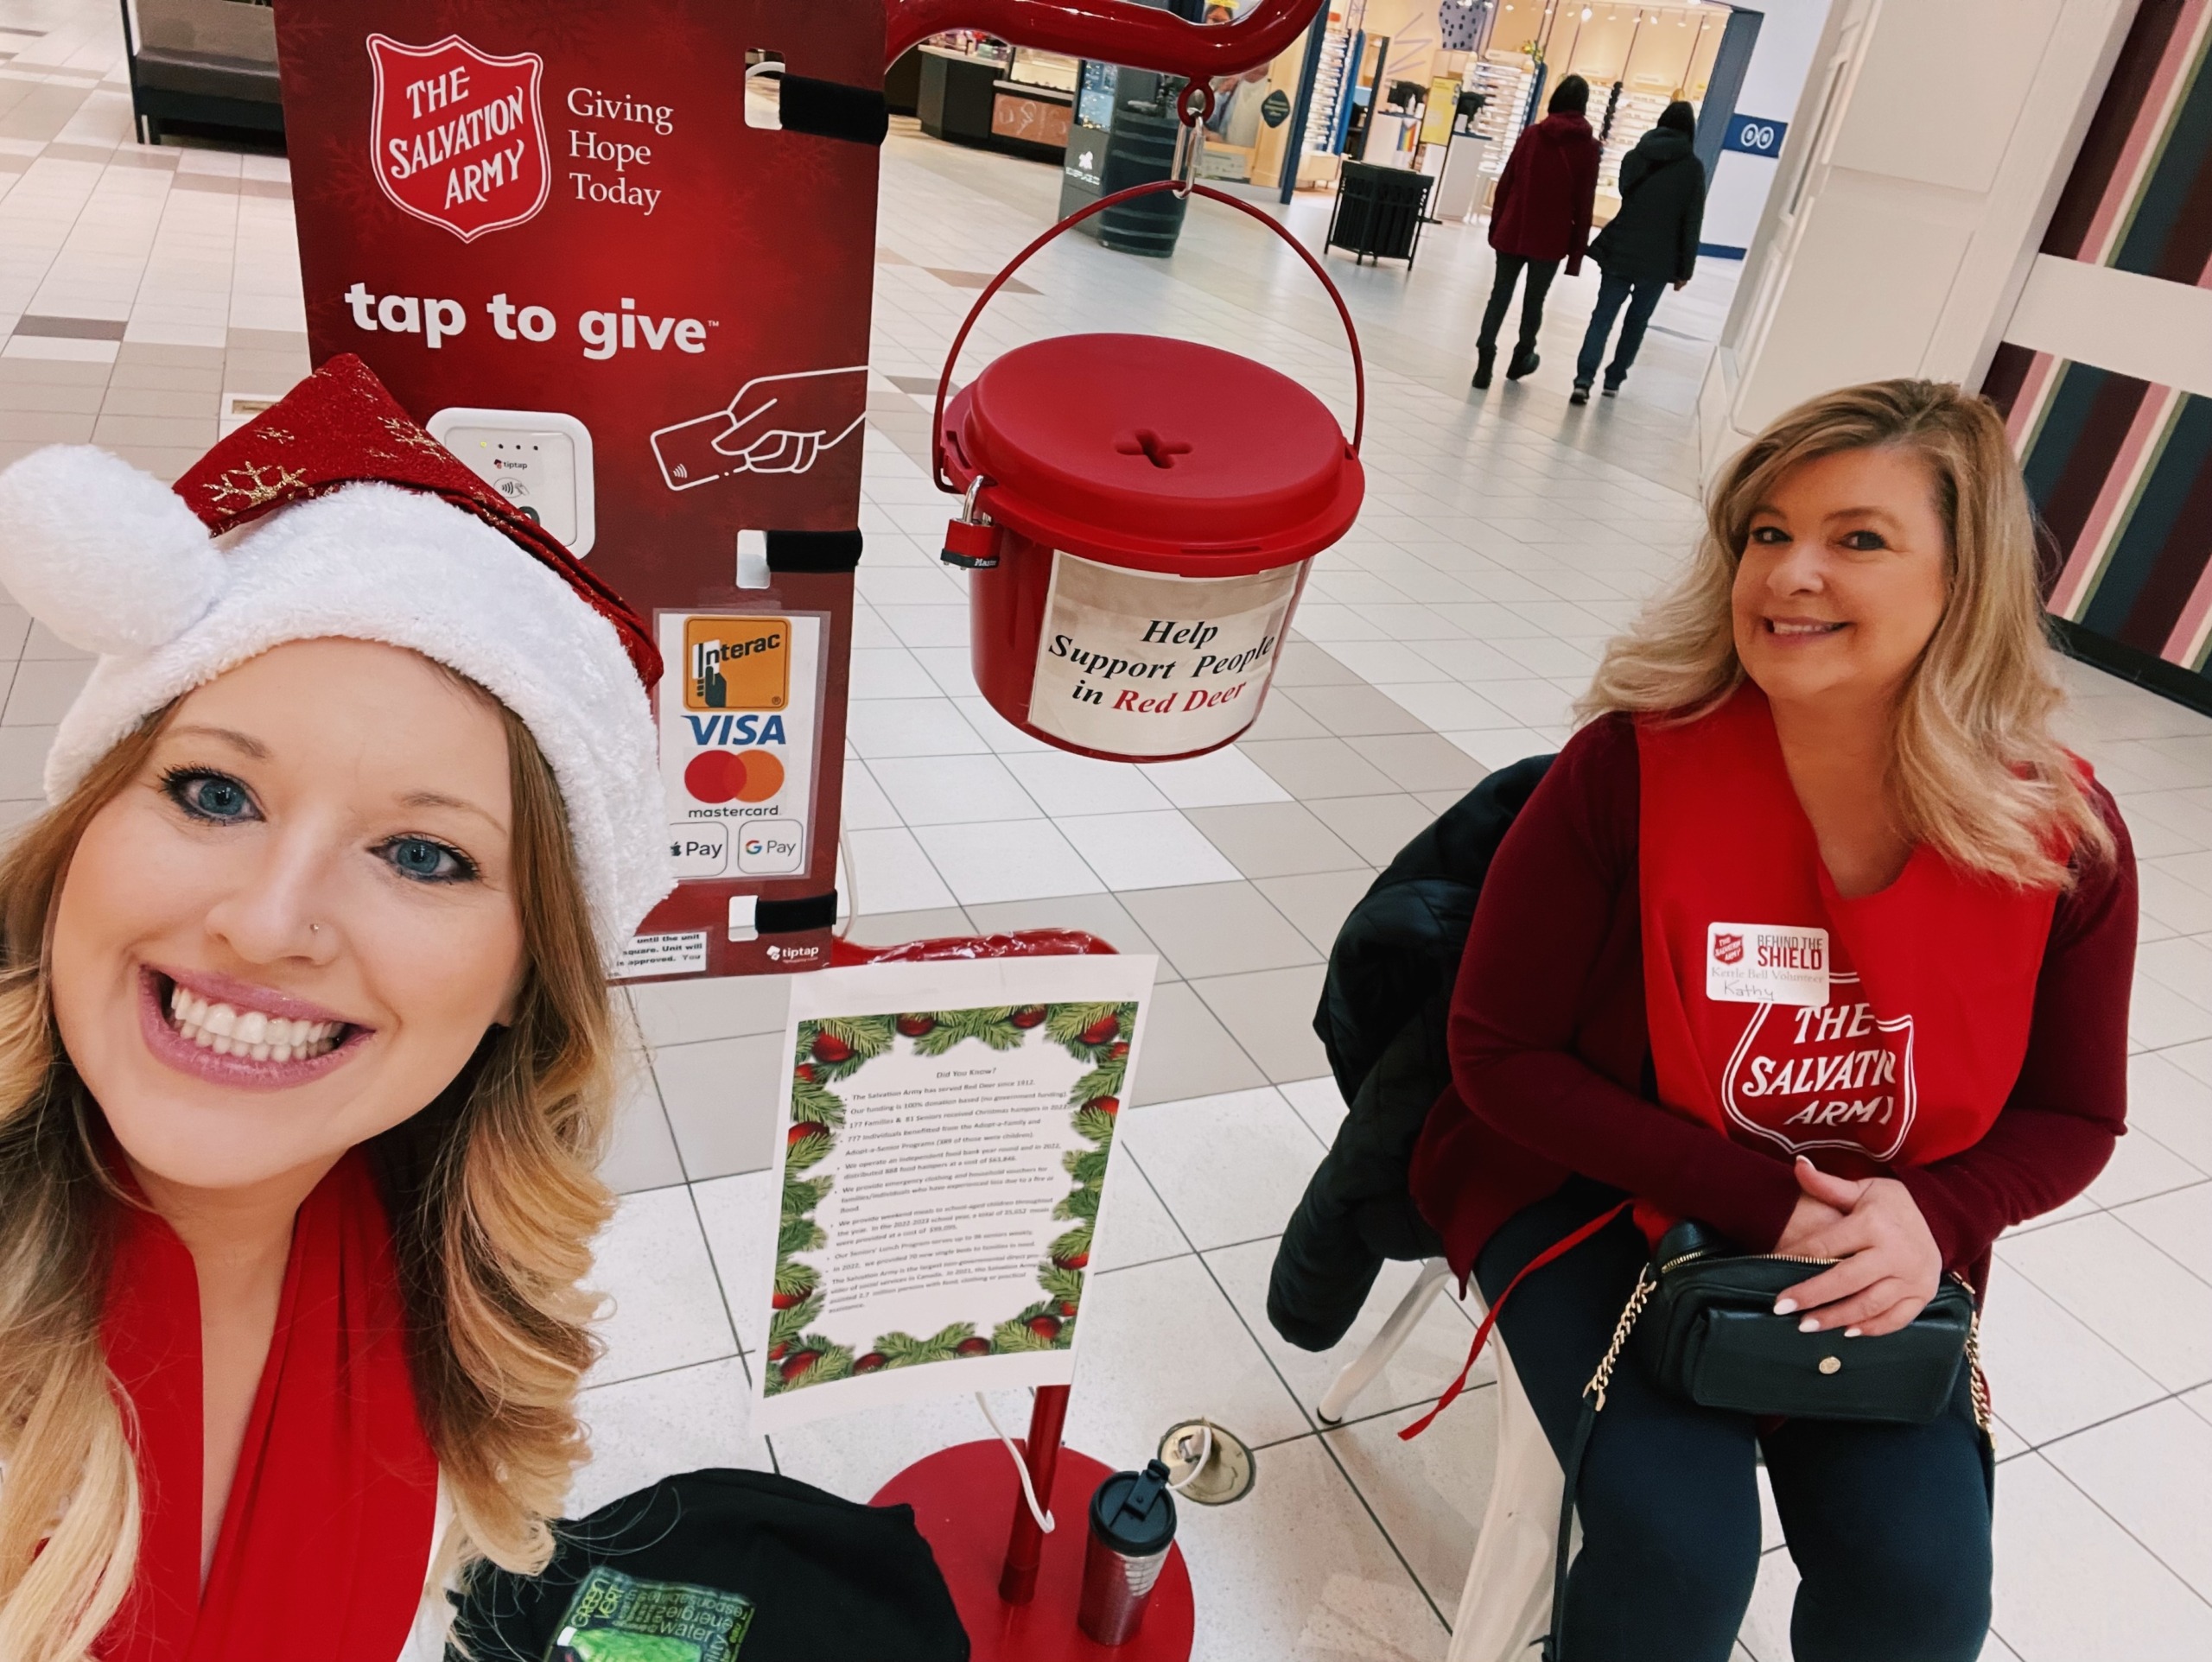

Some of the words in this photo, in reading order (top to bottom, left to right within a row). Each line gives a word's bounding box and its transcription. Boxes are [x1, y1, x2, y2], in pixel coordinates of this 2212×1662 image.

[406, 66, 470, 119] THE
[567, 87, 674, 135] Giving
[389, 86, 523, 179] SALVATION
[569, 130, 652, 172] Hope
[444, 139, 524, 210] ARMY
[570, 173, 662, 215] Today
[345, 282, 466, 348] tap
[486, 293, 556, 341] to
[504, 461, 528, 470] tiptap
[1140, 619, 1219, 650] Help
[698, 633, 781, 678] Interac
[1048, 633, 1177, 680] Support
[1191, 635, 1275, 679] People
[1071, 679, 1104, 706] in
[1111, 689, 1178, 714] Red
[1182, 681, 1247, 714] Deer
[680, 714, 786, 745] VISA
[688, 805, 779, 818] mastercard
[685, 842, 723, 859] Pay
[746, 840, 763, 854] G
[766, 840, 797, 857] Pay
[783, 947, 819, 960] tiptap
[1758, 935, 1798, 949] BEHIND
[1802, 937, 1823, 949] THE
[627, 956, 677, 966] approved.
[1758, 946, 1821, 970] SHIELD
[1712, 967, 1745, 978] Kettle
[1748, 968, 1768, 980] Bell
[1772, 970, 1824, 983] Volunteer
[1724, 980, 1774, 1001] Kathy
[1794, 1003, 1875, 1044] THE
[660, 1621, 715, 1642] water
